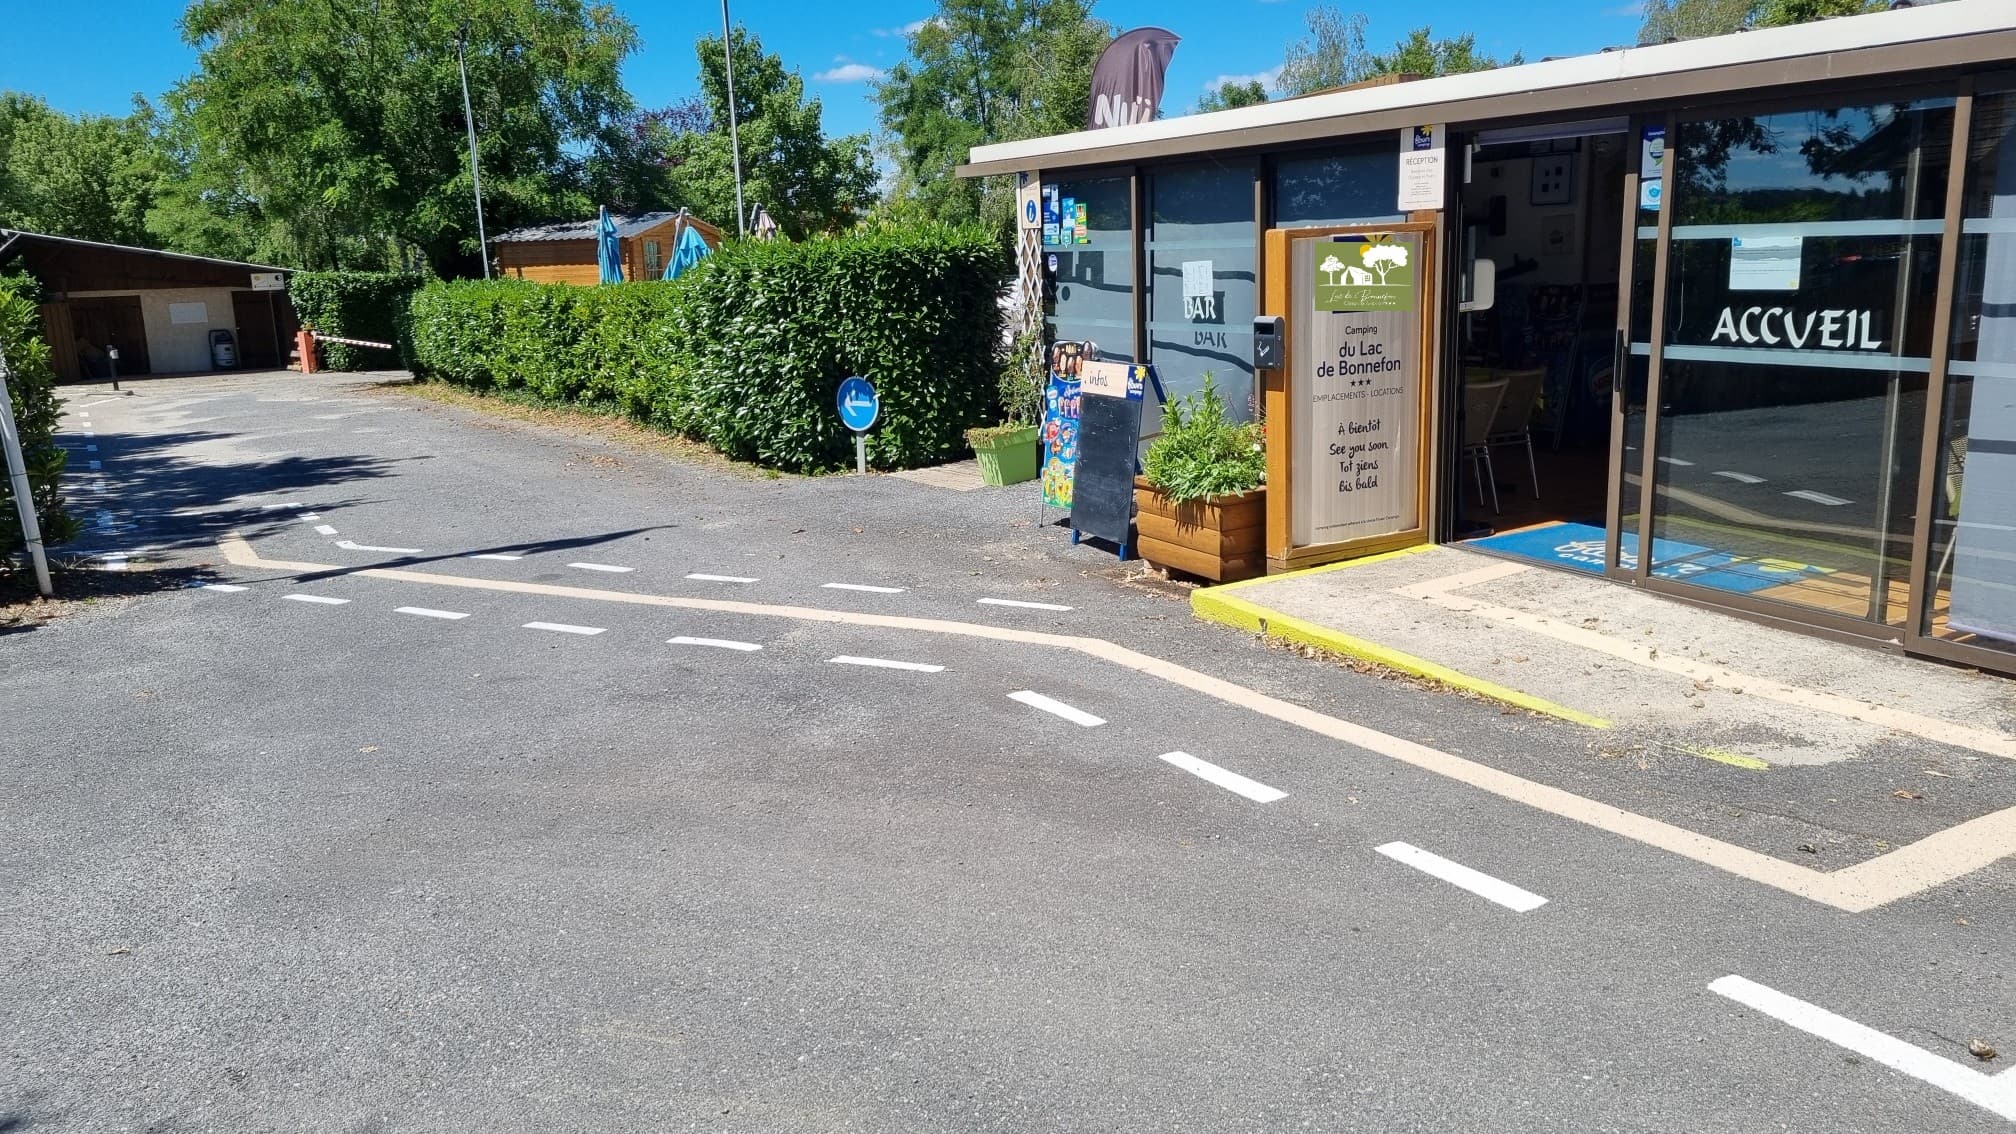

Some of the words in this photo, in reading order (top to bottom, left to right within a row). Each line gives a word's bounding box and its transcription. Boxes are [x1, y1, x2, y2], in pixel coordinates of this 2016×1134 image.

[1183, 296, 1216, 320] BAR
[1345, 325, 1378, 336] Camping
[1339, 341, 1356, 358] du
[1360, 340, 1383, 356] Lac
[1317, 361, 1335, 378] de
[1339, 356, 1401, 376] Bonnefon
[1089, 369, 1109, 387] infos
[1312, 391, 1366, 403] EMPLACEMENTS
[1371, 386, 1404, 398] LOCATIONS
[1329, 443, 1346, 456] See
[1349, 444, 1366, 459] you
[1368, 441, 1390, 452] soon
[1339, 460, 1353, 473] Tot
[1356, 459, 1379, 477] ziens
[1355, 475, 1378, 490] bald
